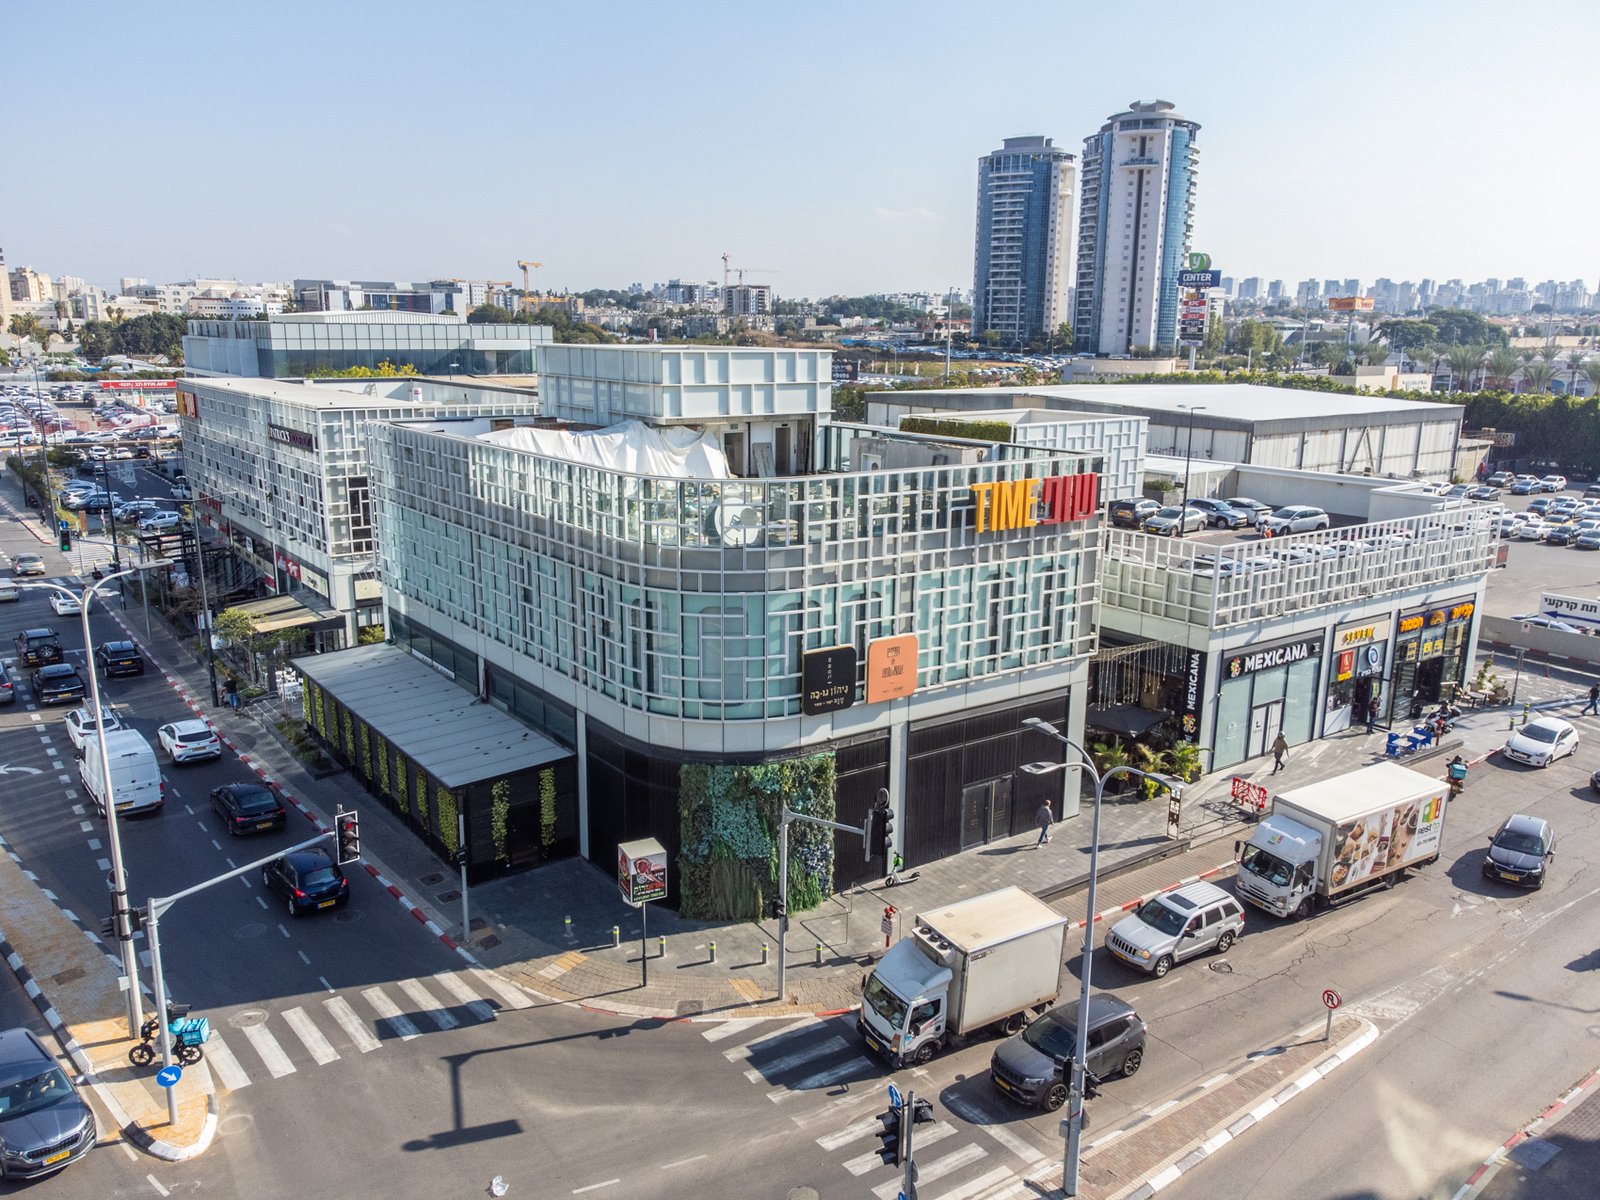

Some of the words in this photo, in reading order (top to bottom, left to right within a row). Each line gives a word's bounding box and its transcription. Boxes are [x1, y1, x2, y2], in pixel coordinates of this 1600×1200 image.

[1183, 273, 1212, 281] CENTER
[971, 478, 1039, 533] TIME
[1544, 597, 1578, 611] קרקעי
[1581, 603, 1598, 613] תת
[1345, 626, 1376, 642] SEVEN
[1244, 643, 1308, 673] MEXICANA
[1187, 653, 1200, 710] MEXICANA
